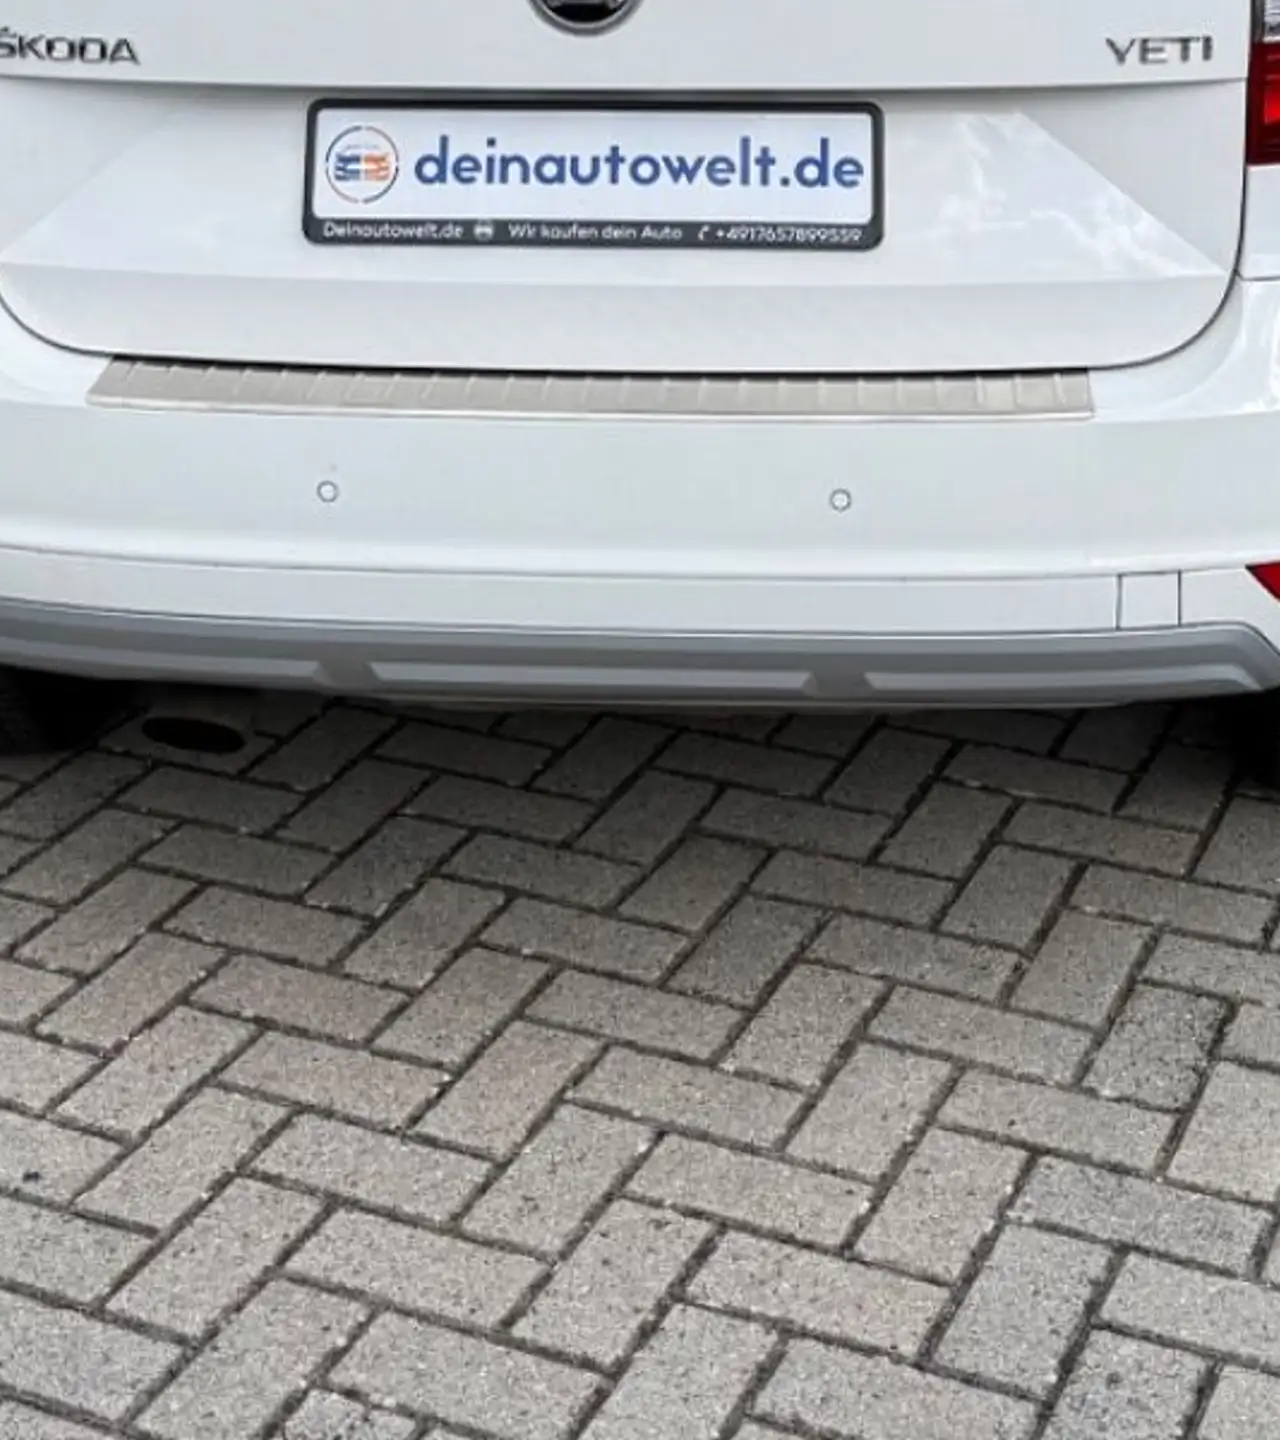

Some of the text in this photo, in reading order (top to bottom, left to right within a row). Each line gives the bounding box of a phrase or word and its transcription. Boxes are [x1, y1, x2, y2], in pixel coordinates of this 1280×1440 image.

[1105, 35, 1213, 65] YETI
[413, 136, 865, 188] deinautowelt.de
[322, 220, 464, 240] Deinautowelt.de
[508, 223, 536, 239] Wir
[540, 222, 599, 240] kaufen
[601, 223, 637, 240] dein
[640, 224, 683, 241] Auto
